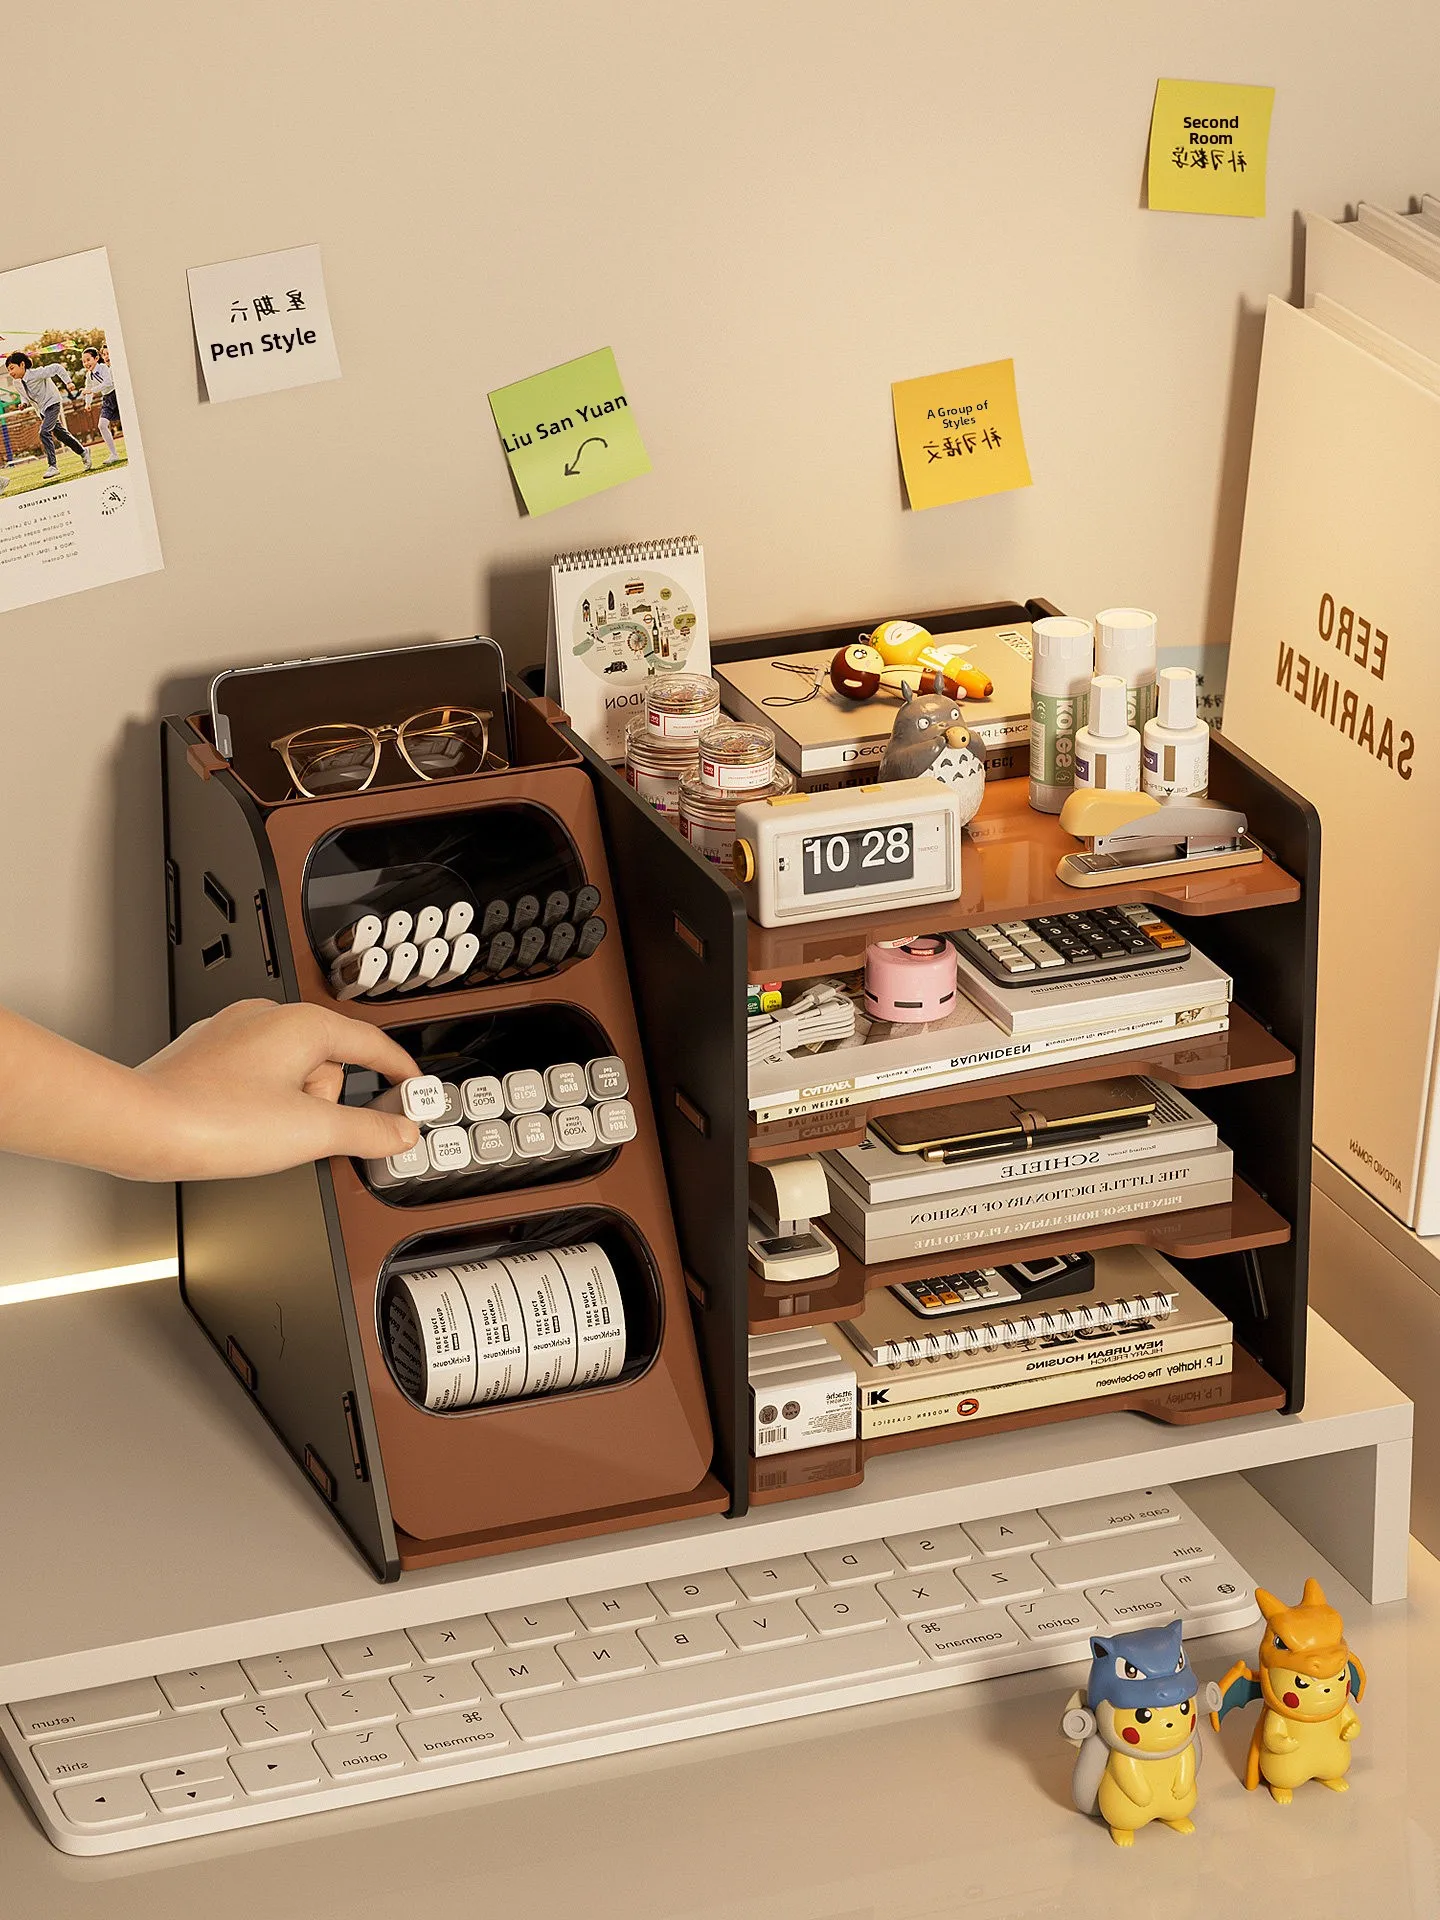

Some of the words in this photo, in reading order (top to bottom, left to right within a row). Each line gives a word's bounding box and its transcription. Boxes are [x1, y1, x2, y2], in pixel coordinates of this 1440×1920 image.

[1183, 116, 1239, 129] Second
[1189, 132, 1233, 145] Room
[210, 340, 254, 362] Pen
[260, 327, 317, 355] Style
[927, 409, 936, 420] A
[937, 404, 973, 418] Group
[976, 400, 989, 411] of
[502, 432, 533, 454] Liu
[536, 416, 574, 441] San
[575, 394, 628, 424] Yuan
[942, 415, 976, 429] Styles
[803, 835, 850, 875] 10
[861, 826, 910, 868] 28
[412, 1086, 439, 1096] Yellow
[420, 1097, 436, 1106] Y06
[472, 1096, 496, 1107] BG05
[564, 1126, 587, 1136] YG09
[439, 1146, 462, 1157] BG02
[480, 1139, 504, 1150] YG97
[531, 1300, 539, 1317] DUCT
[581, 1291, 589, 1309] DUCT
[430, 1317, 439, 1335] DUCT
[481, 1309, 490, 1326] DUCT
[585, 1310, 593, 1328] FREE
[535, 1319, 543, 1336] FREE
[442, 1335, 450, 1352] TAPE
[485, 1328, 493, 1345] FREE
